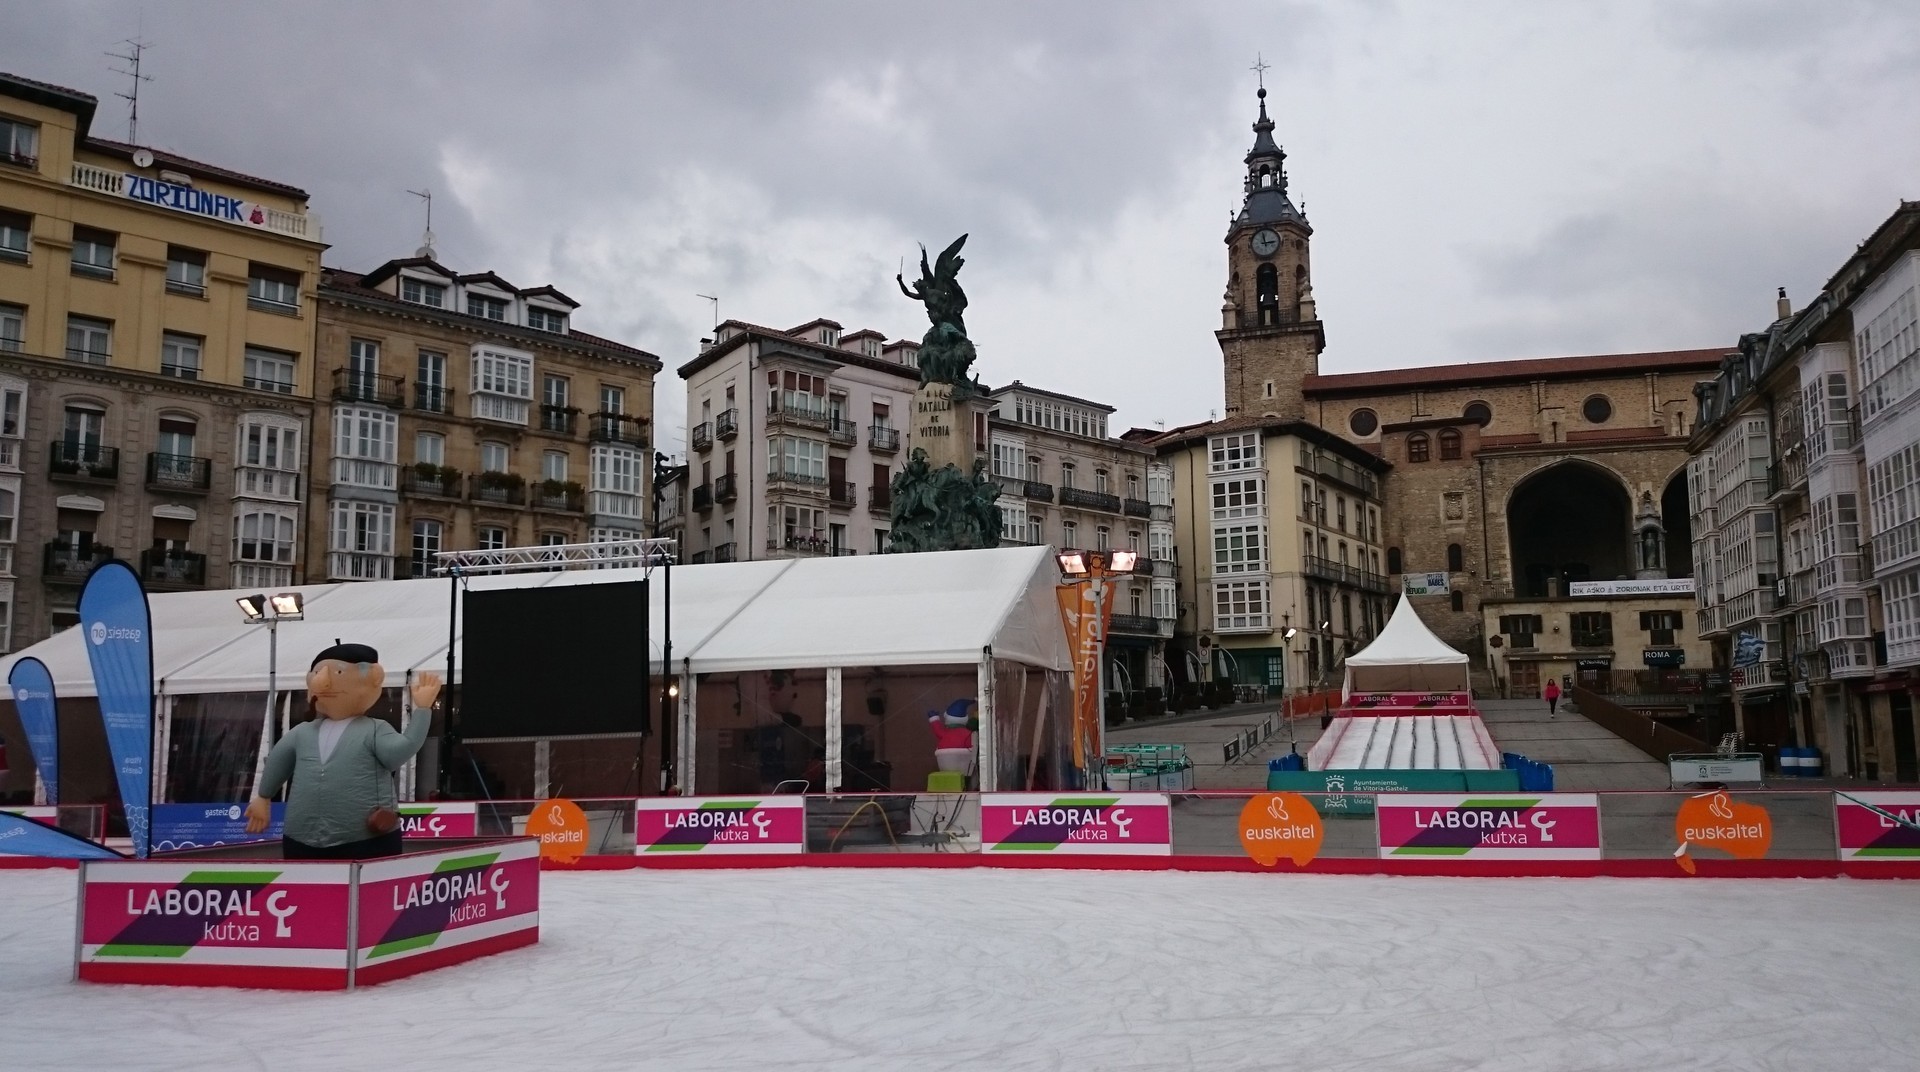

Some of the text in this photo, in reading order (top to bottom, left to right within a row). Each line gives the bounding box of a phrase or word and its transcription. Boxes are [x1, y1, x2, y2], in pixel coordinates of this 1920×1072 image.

[126, 174, 244, 222] ZORIONAK
[918, 400, 952, 413] BATALLA
[930, 415, 939, 423] DE
[920, 425, 950, 438] VITORIA
[1405, 587, 1427, 595] REFUGIO
[1615, 585, 1651, 593] ZORIONAK
[1653, 584, 1668, 592] ETA
[1670, 583, 1691, 591] URTE
[1645, 651, 1671, 659] ROMA
[1353, 779, 1398, 787] Ayuntamiento
[1363, 784, 1408, 792] Vitoria-Gasteiz
[205, 807, 229, 818] gasteiz
[1012, 809, 1107, 826] LABORAL
[665, 811, 749, 828] LABORAL
[1414, 810, 1526, 829] LABORAL
[713, 829, 749, 841] kutxa
[1068, 827, 1108, 840] kutxa
[1246, 824, 1315, 840] euskaltel
[1481, 831, 1528, 845] kutxa
[1684, 823, 1763, 840] euskaltel
[393, 871, 487, 911] LABORAL
[127, 888, 260, 917] LABORAL
[450, 901, 486, 924] kutxa
[203, 921, 260, 941] kutxa
